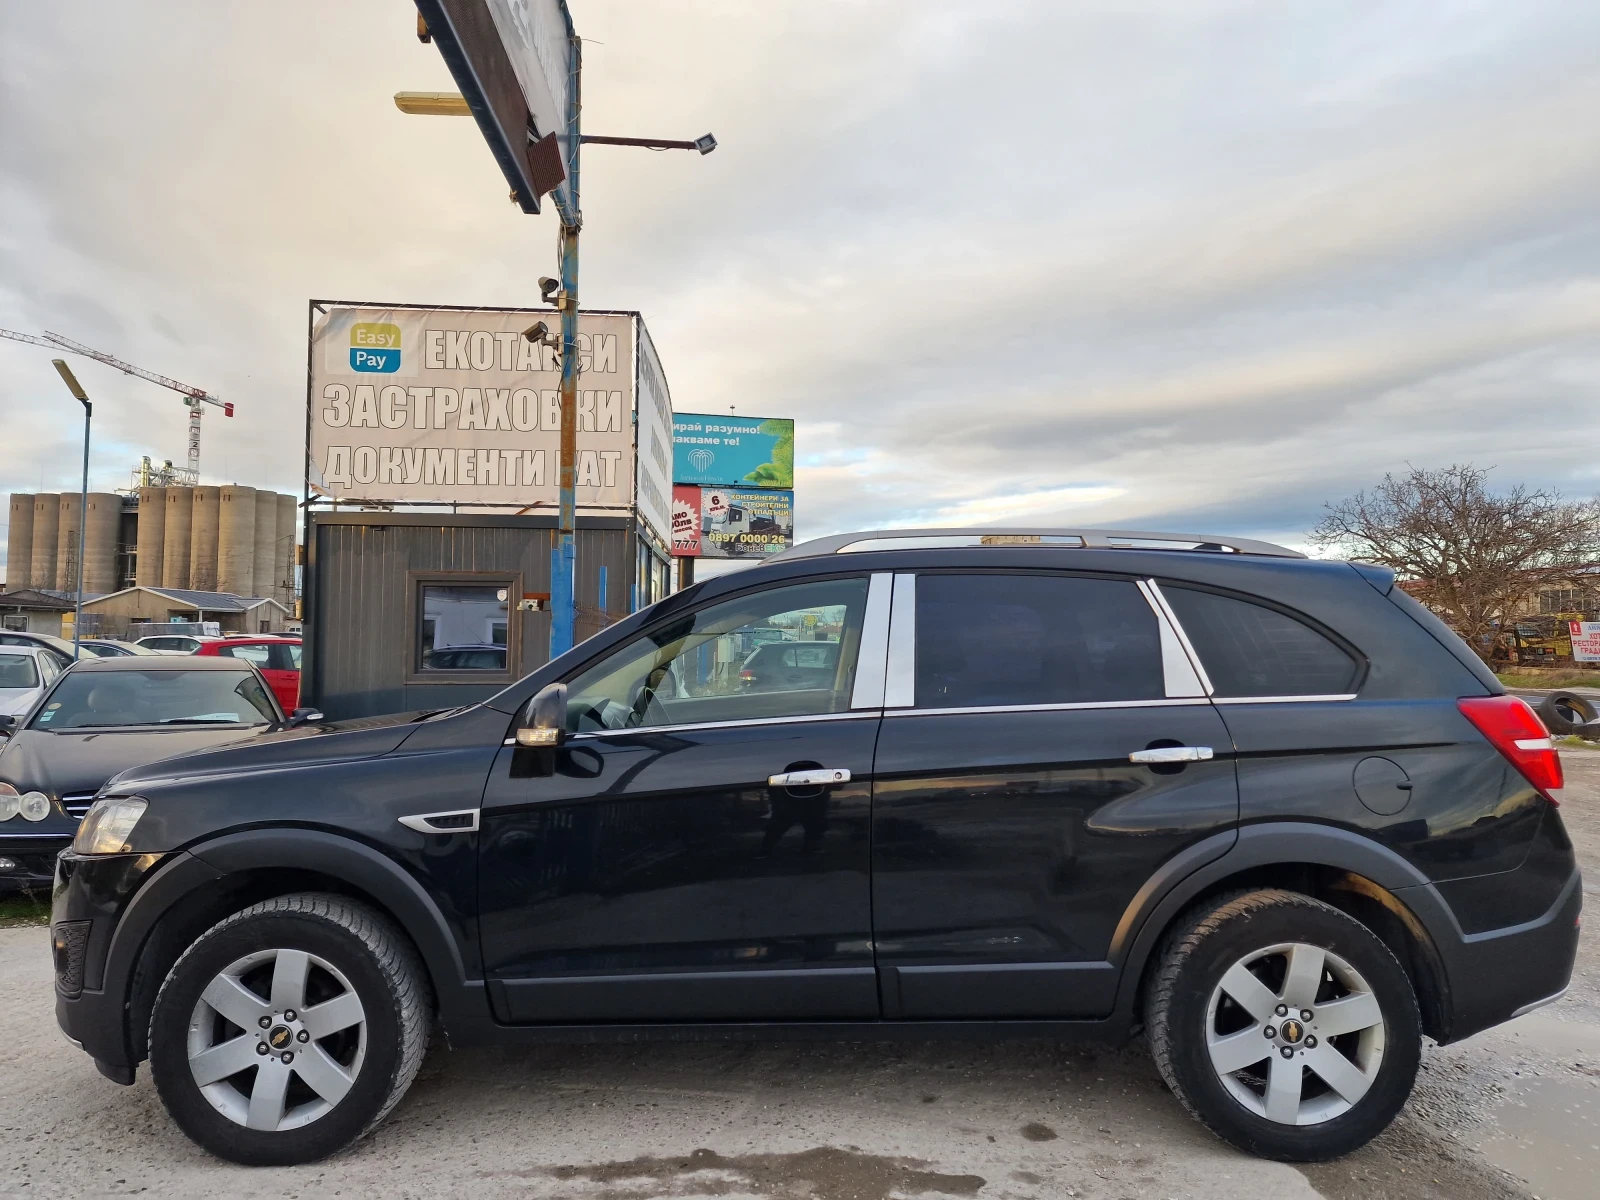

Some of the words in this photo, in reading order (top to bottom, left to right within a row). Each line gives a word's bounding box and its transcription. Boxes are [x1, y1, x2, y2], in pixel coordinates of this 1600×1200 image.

[357, 329, 396, 347] Easy
[356, 351, 387, 370] Pay
[322, 383, 622, 433] ЗАСТРАХОВКИ
[705, 424, 760, 434] разумно!
[723, 437, 740, 446] те!
[322, 445, 546, 490] ДОКУМЕНТИ
[711, 495, 720, 505] 6
[731, 493, 778, 501] КОНТЕЙНЕРИ
[708, 533, 737, 543] 0897
[740, 534, 768, 543] 0000
[771, 535, 785, 544] 26
